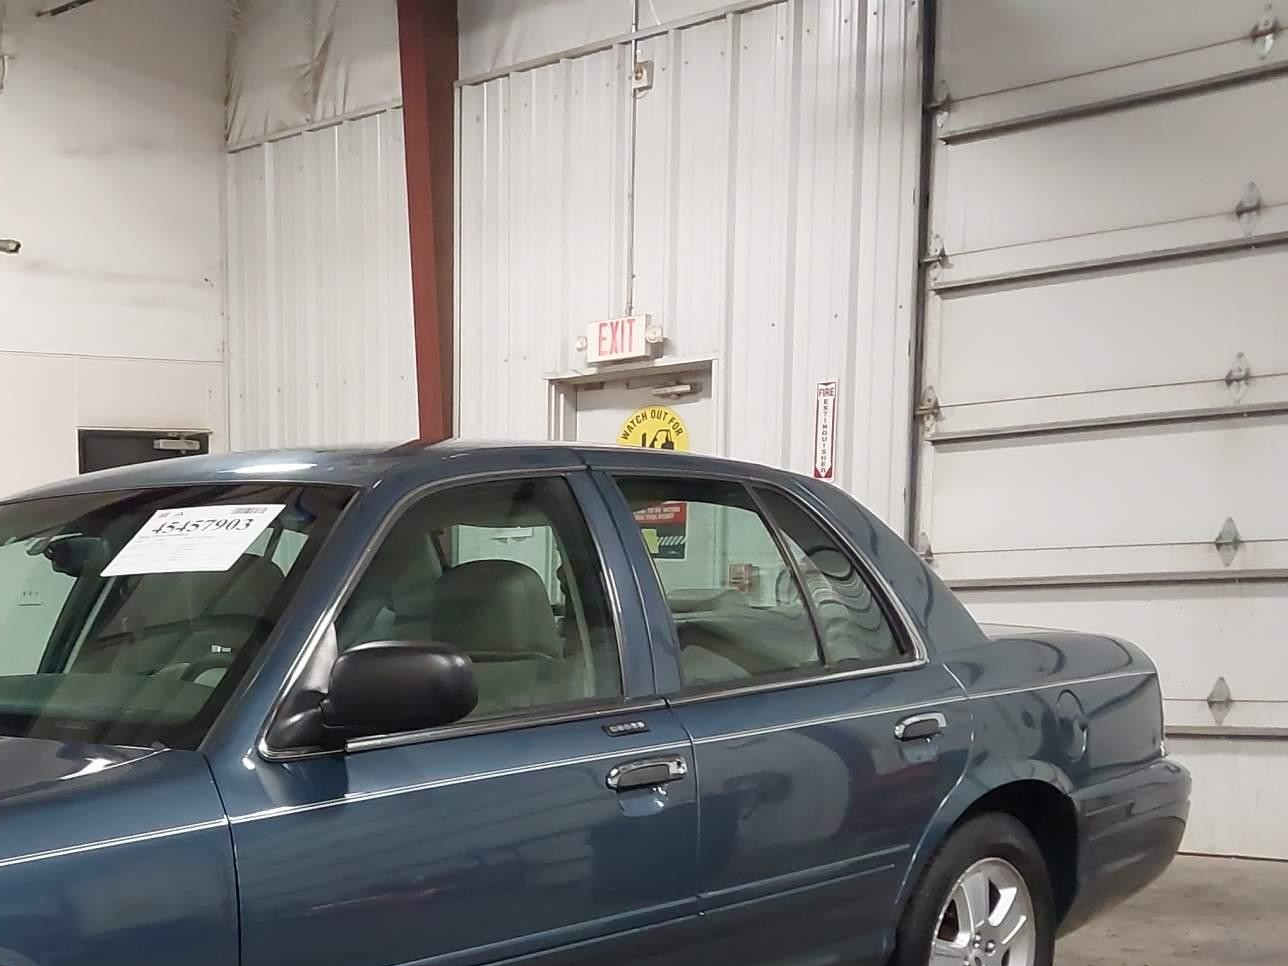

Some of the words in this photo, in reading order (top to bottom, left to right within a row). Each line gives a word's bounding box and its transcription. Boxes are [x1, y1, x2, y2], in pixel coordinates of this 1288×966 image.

[598, 318, 637, 356] EXIT
[818, 387, 835, 398] FIRE
[621, 411, 648, 440] WATCH
[650, 409, 669, 420] OUT
[667, 417, 684, 437] FOR
[152, 518, 254, 535] 45457903
